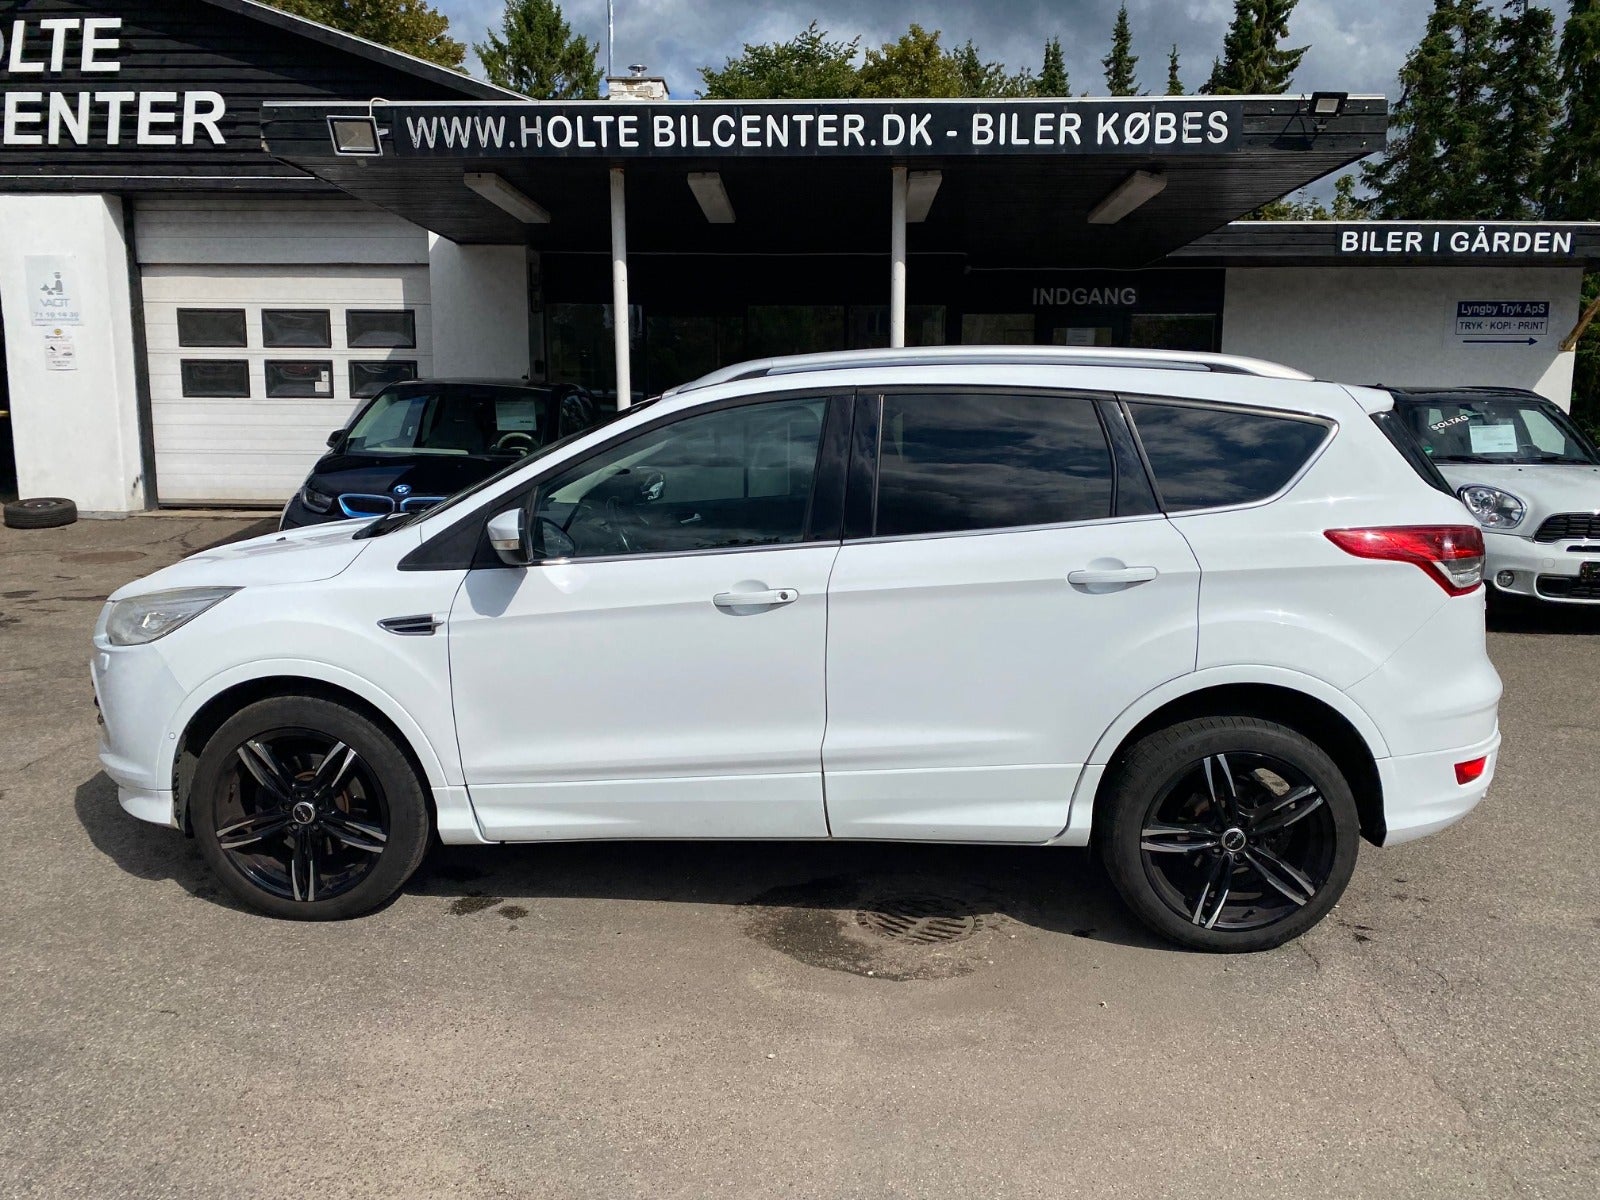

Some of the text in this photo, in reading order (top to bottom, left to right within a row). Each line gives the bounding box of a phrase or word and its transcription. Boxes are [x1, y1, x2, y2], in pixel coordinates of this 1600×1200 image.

[0, 18, 122, 73] LTE
[3, 90, 227, 145] ENTER
[406, 116, 640, 148] WWW.HOLTE
[653, 113, 933, 147] BILCENTER.DK
[971, 111, 1082, 145] BILER
[1096, 111, 1229, 145] KØBES
[1341, 226, 1572, 252] BILER I GÅRDEN
[1032, 287, 1137, 305] INDGANG
[1461, 303, 1545, 316] Lyngby Tryk ApS
[1460, 321, 1483, 330] TRYK
[1490, 321, 1512, 330] KOPI
[1518, 321, 1545, 330] PRINT
